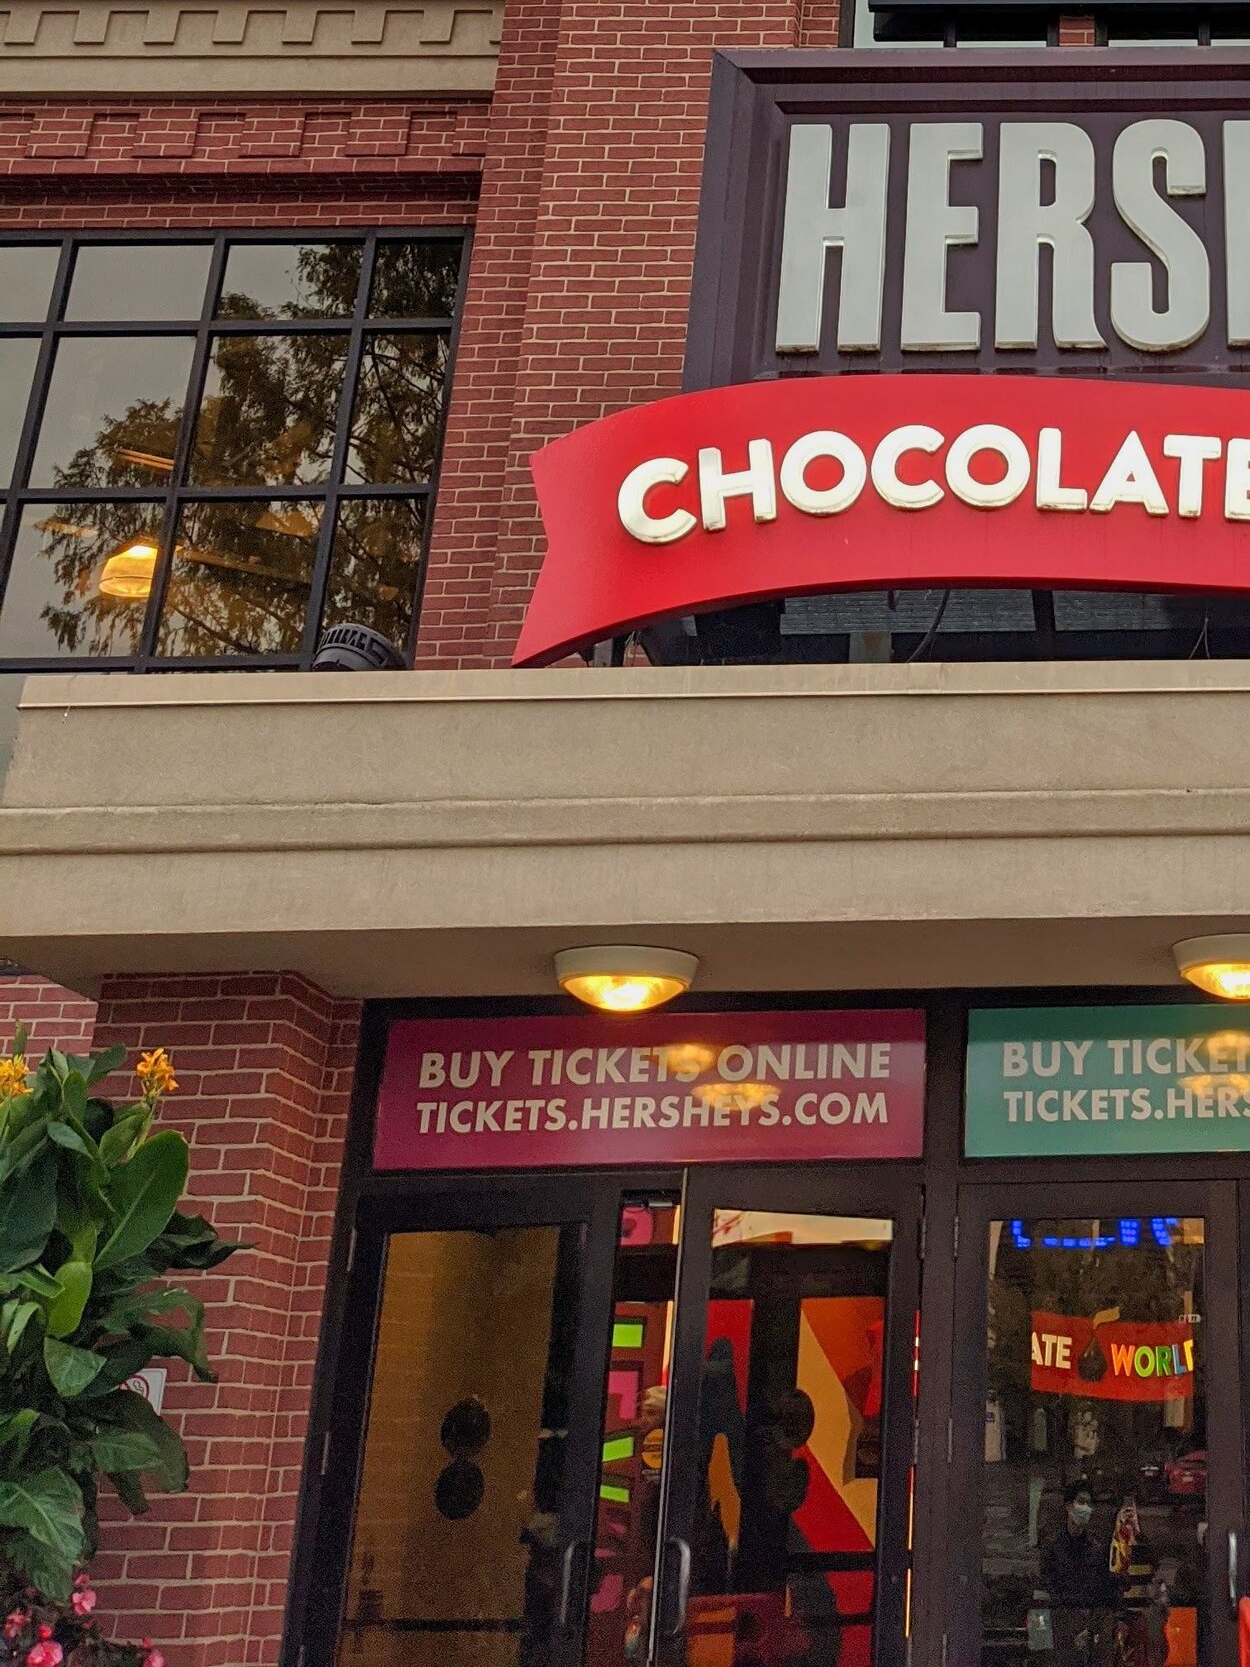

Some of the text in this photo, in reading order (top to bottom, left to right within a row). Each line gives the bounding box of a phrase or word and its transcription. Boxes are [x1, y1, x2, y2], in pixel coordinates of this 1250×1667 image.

[418, 1042, 891, 1088] BUY TICKETS ONLINE
[1002, 1040, 1095, 1078] BUY
[416, 1091, 889, 1134] TICKETS.HERSHEYS.COM
[1031, 1332, 1072, 1369] ATE
